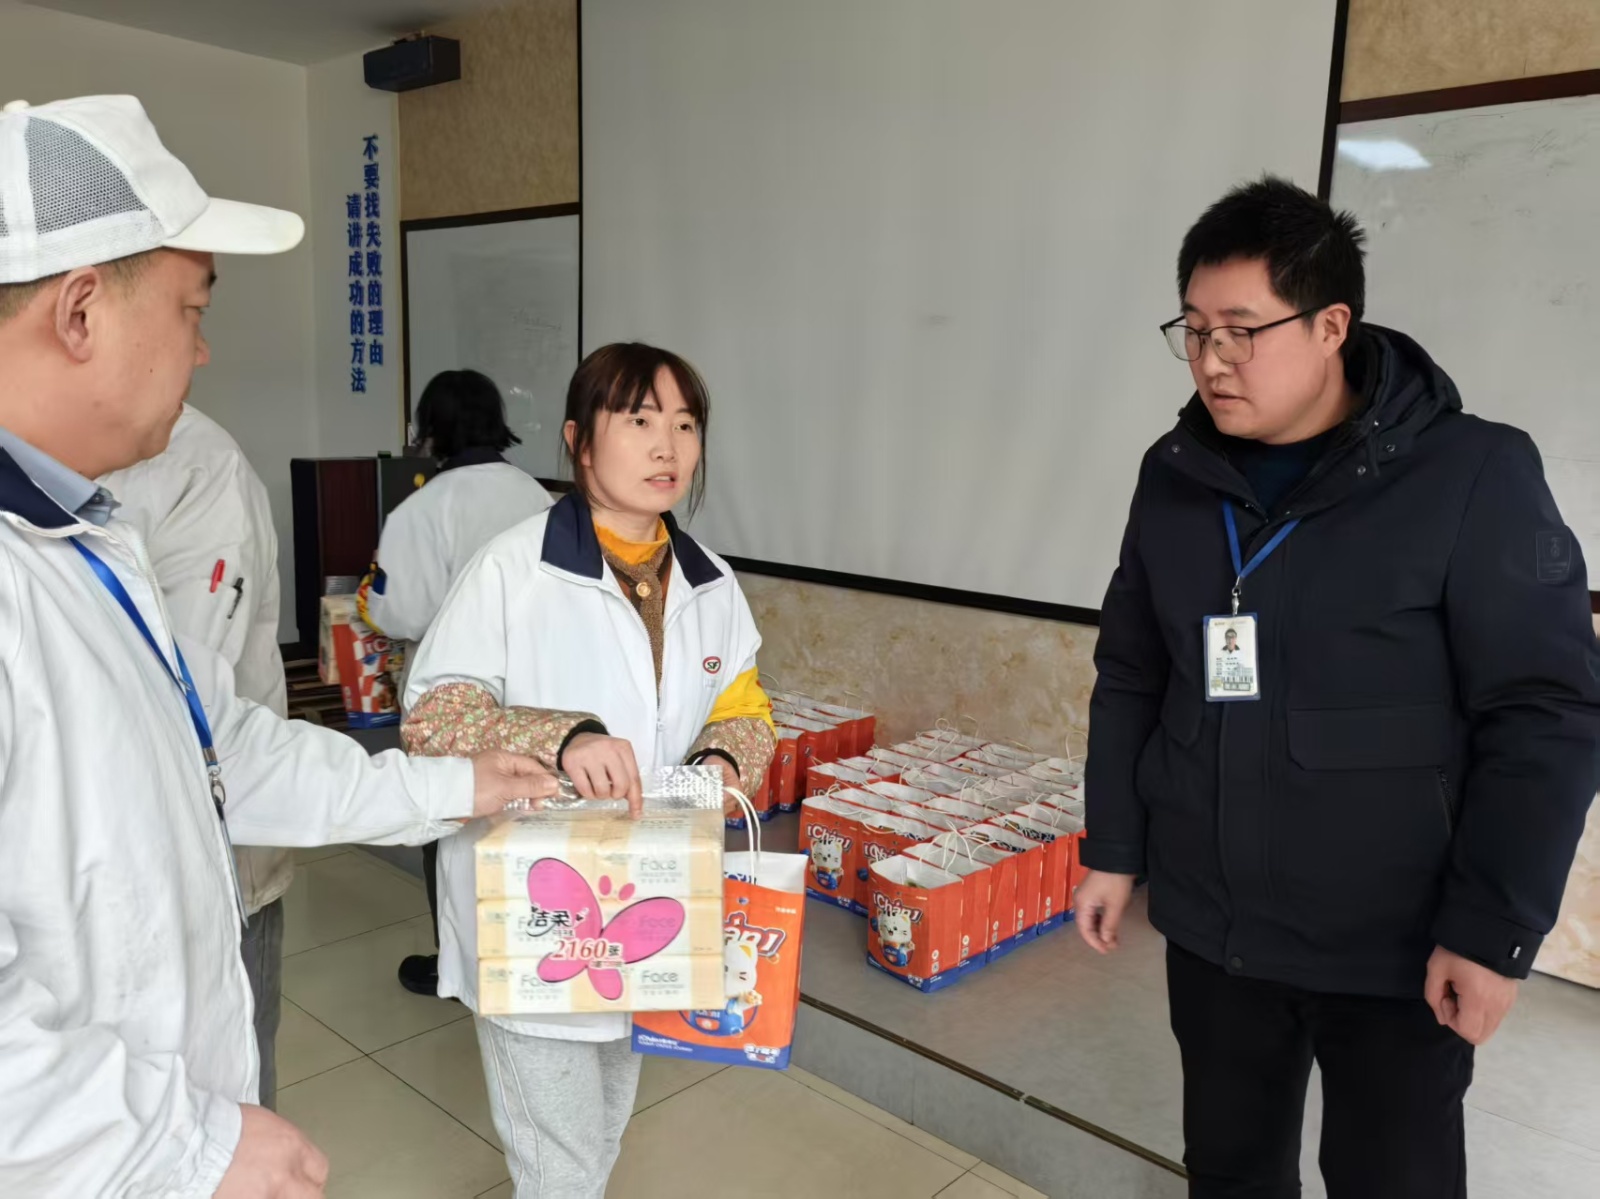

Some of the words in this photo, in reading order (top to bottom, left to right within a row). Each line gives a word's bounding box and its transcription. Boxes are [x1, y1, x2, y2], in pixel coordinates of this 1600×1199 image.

[363, 134, 383, 366] 不要找失败的理由
[346, 194, 366, 394] 请讲成功的方法
[641, 858, 677, 870] Face
[526, 906, 572, 936] 洁柔
[642, 970, 679, 983] Face
